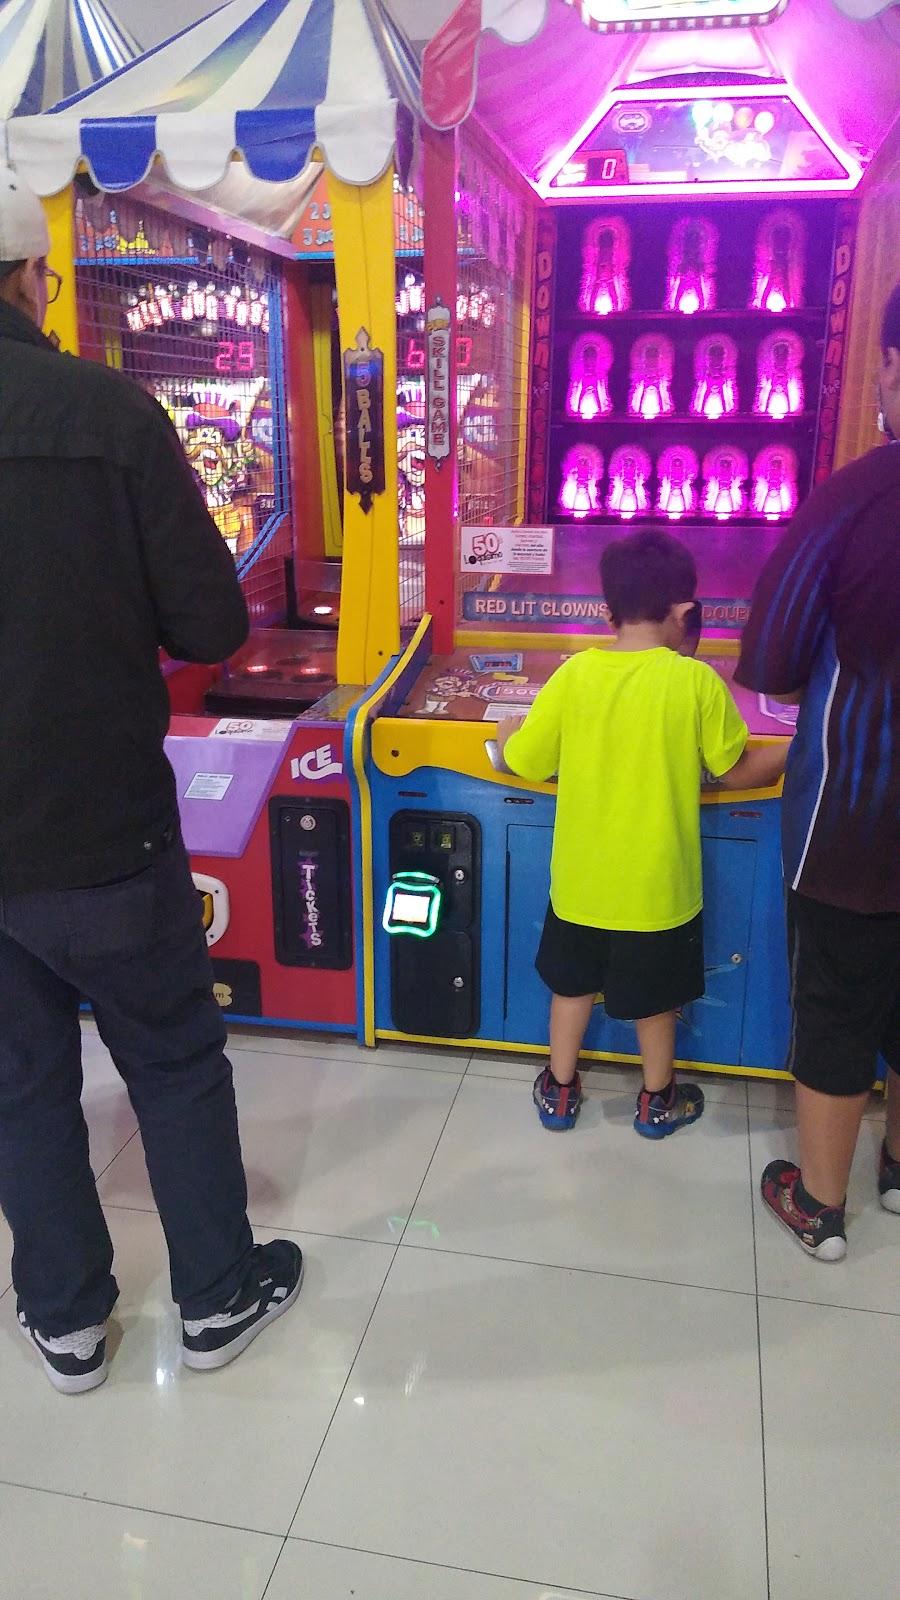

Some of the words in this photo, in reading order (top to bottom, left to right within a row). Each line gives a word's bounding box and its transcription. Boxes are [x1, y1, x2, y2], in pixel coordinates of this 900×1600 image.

[602, 158, 617, 180] 0
[356, 362, 371, 387] 5
[432, 336, 447, 391] SKILL
[431, 397, 447, 446] GAME
[356, 388, 373, 484] BALLS
[472, 532, 500, 556] 50
[475, 599, 507, 614] RED
[511, 600, 537, 616] LIT
[226, 721, 253, 731] 50
[291, 744, 343, 780] ICE
